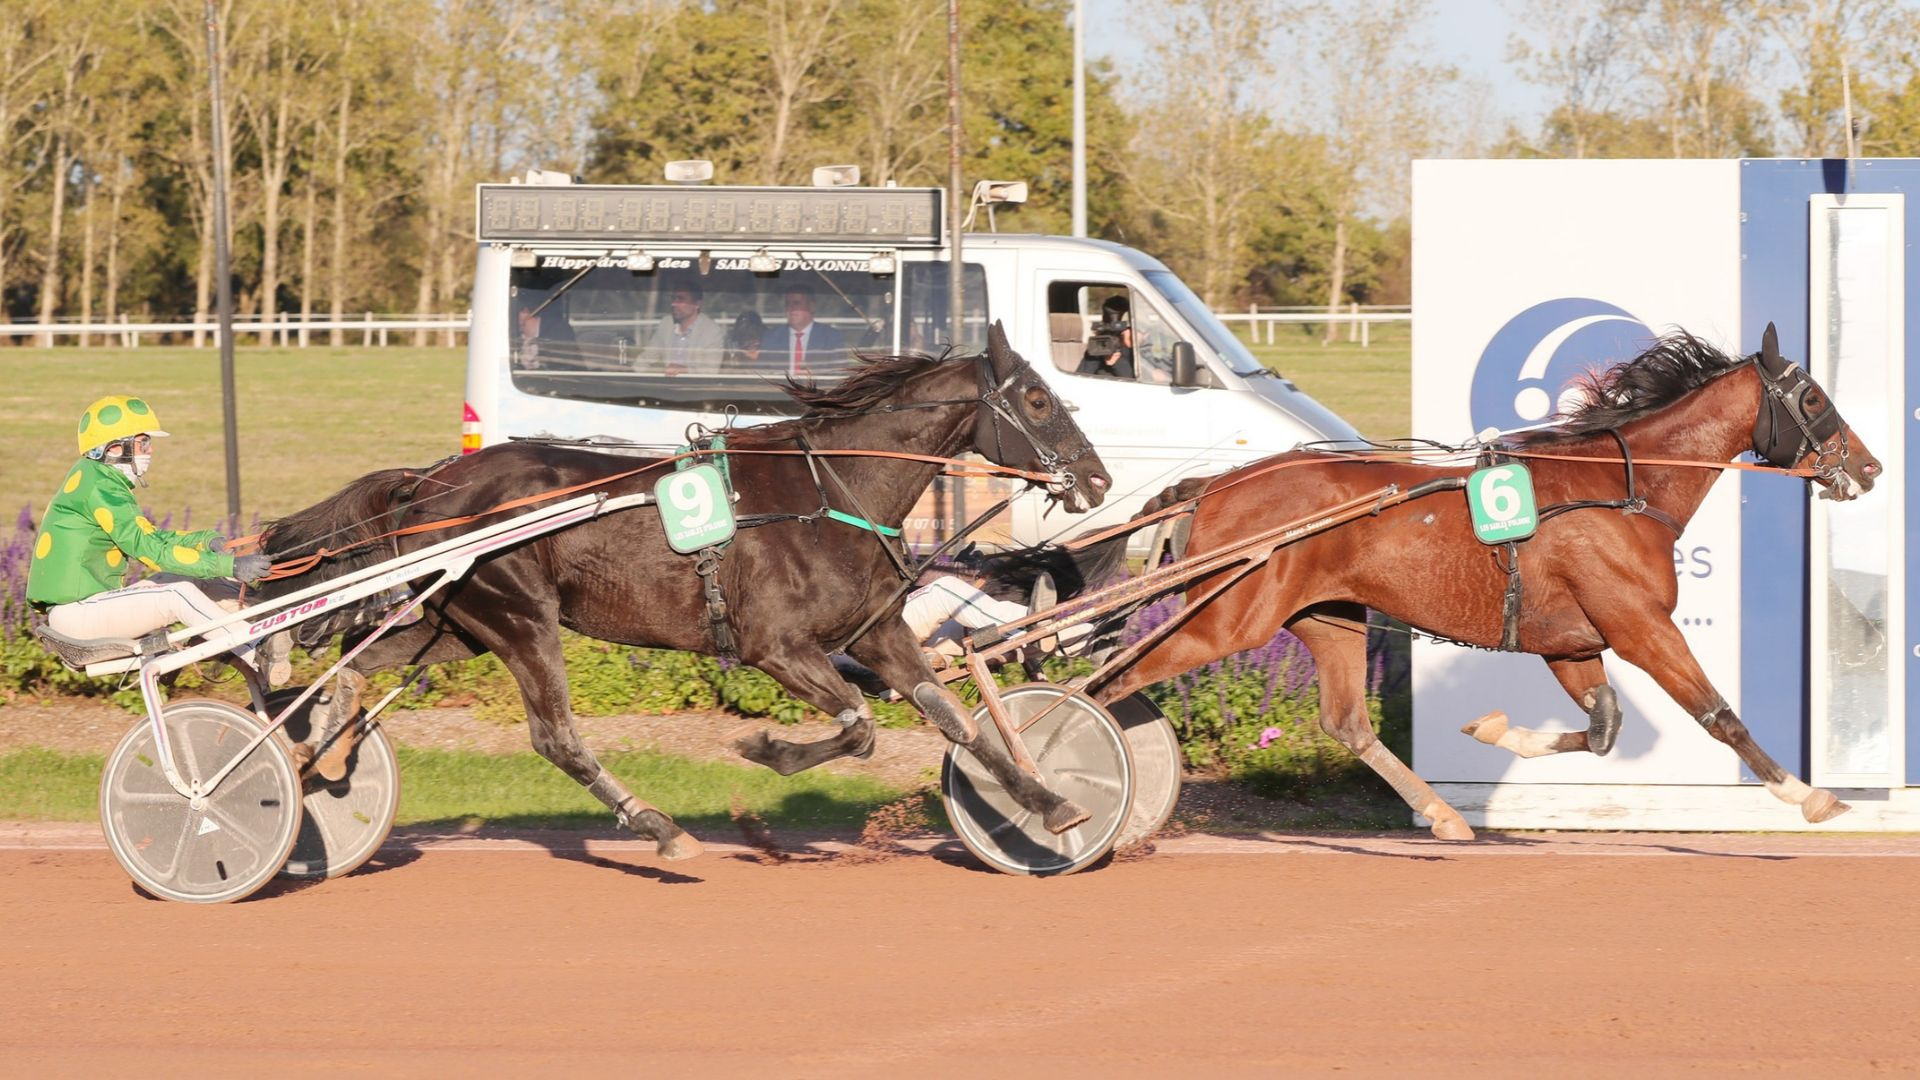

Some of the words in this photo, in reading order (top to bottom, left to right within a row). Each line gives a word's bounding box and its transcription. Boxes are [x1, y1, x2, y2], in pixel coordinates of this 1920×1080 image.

[542, 257, 655, 269] Hippodro
[658, 258, 691, 269] des
[715, 259, 782, 270] SABS
[669, 472, 713, 528] 9
[1480, 468, 1521, 521] 6
[248, 597, 329, 635] CUSTOM
